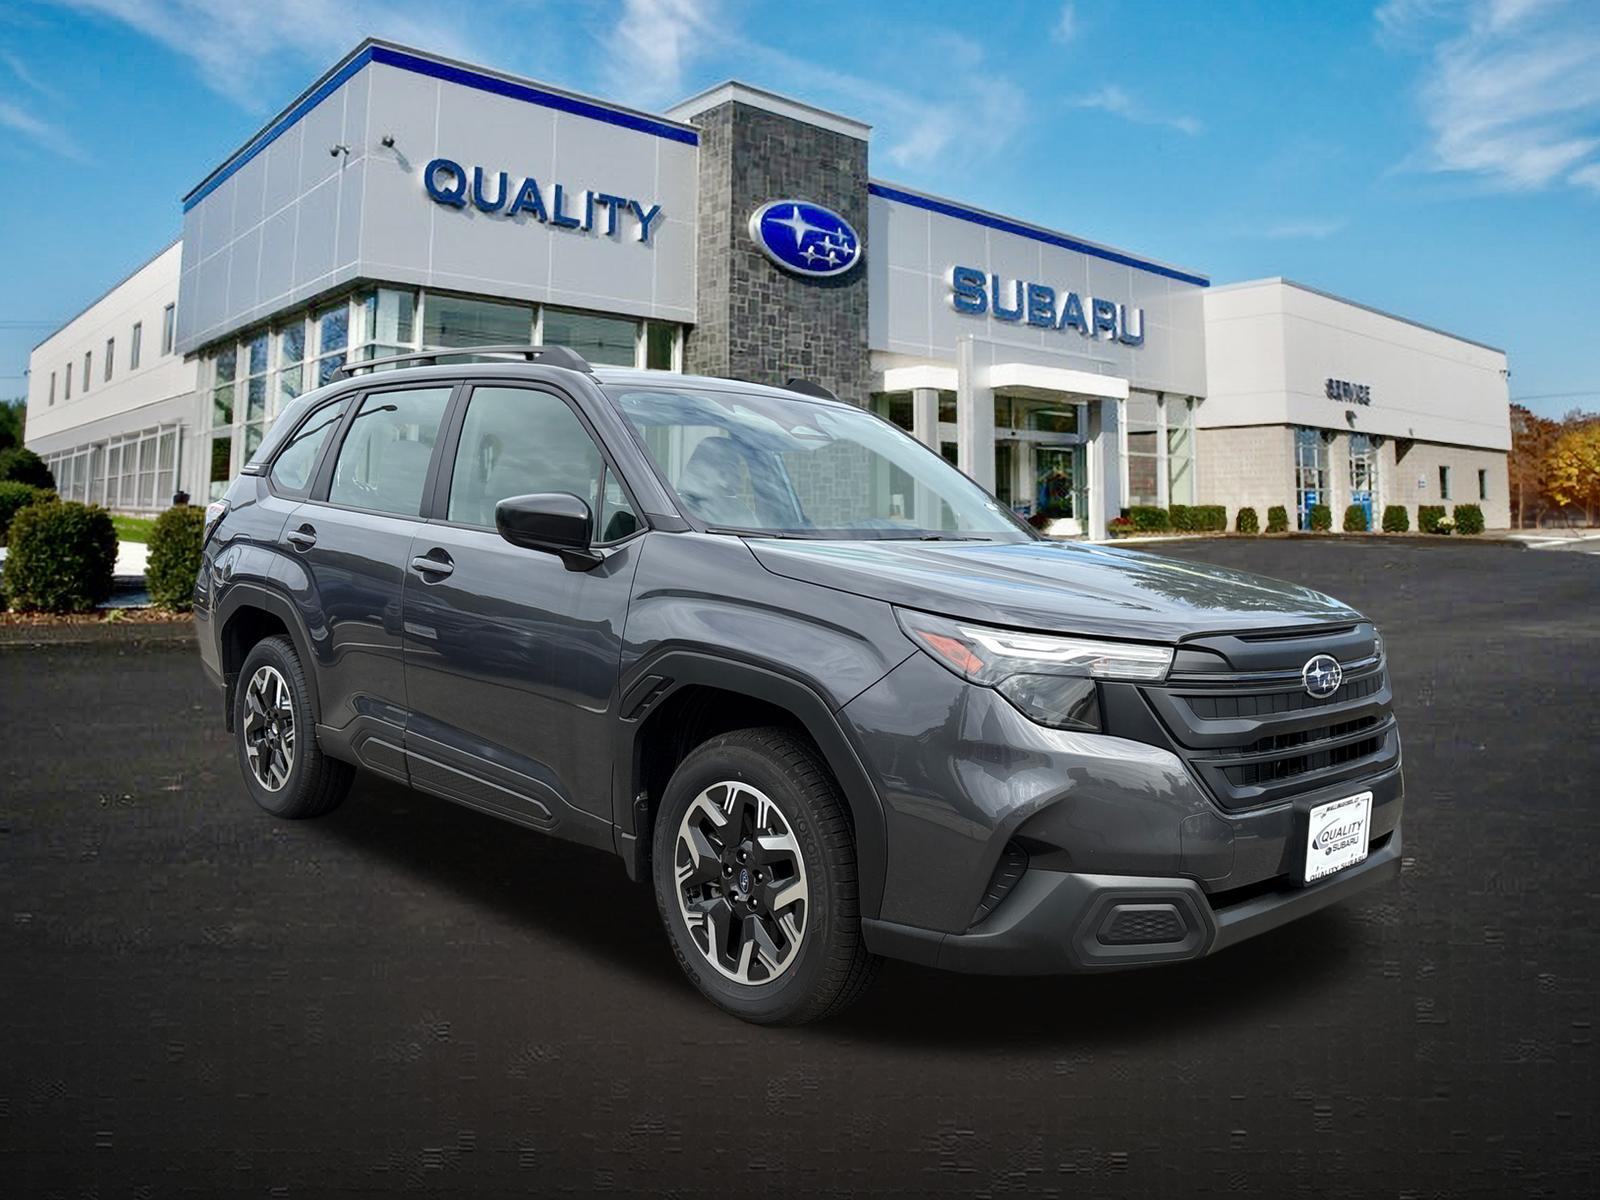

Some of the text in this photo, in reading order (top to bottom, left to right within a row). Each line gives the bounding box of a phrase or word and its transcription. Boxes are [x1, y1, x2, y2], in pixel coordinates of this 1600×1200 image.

[424, 158, 661, 243] QUALITY
[947, 265, 1145, 347] SUBARU
[1321, 819, 1364, 843] QUALITY
[1332, 835, 1360, 852] SUBARU
